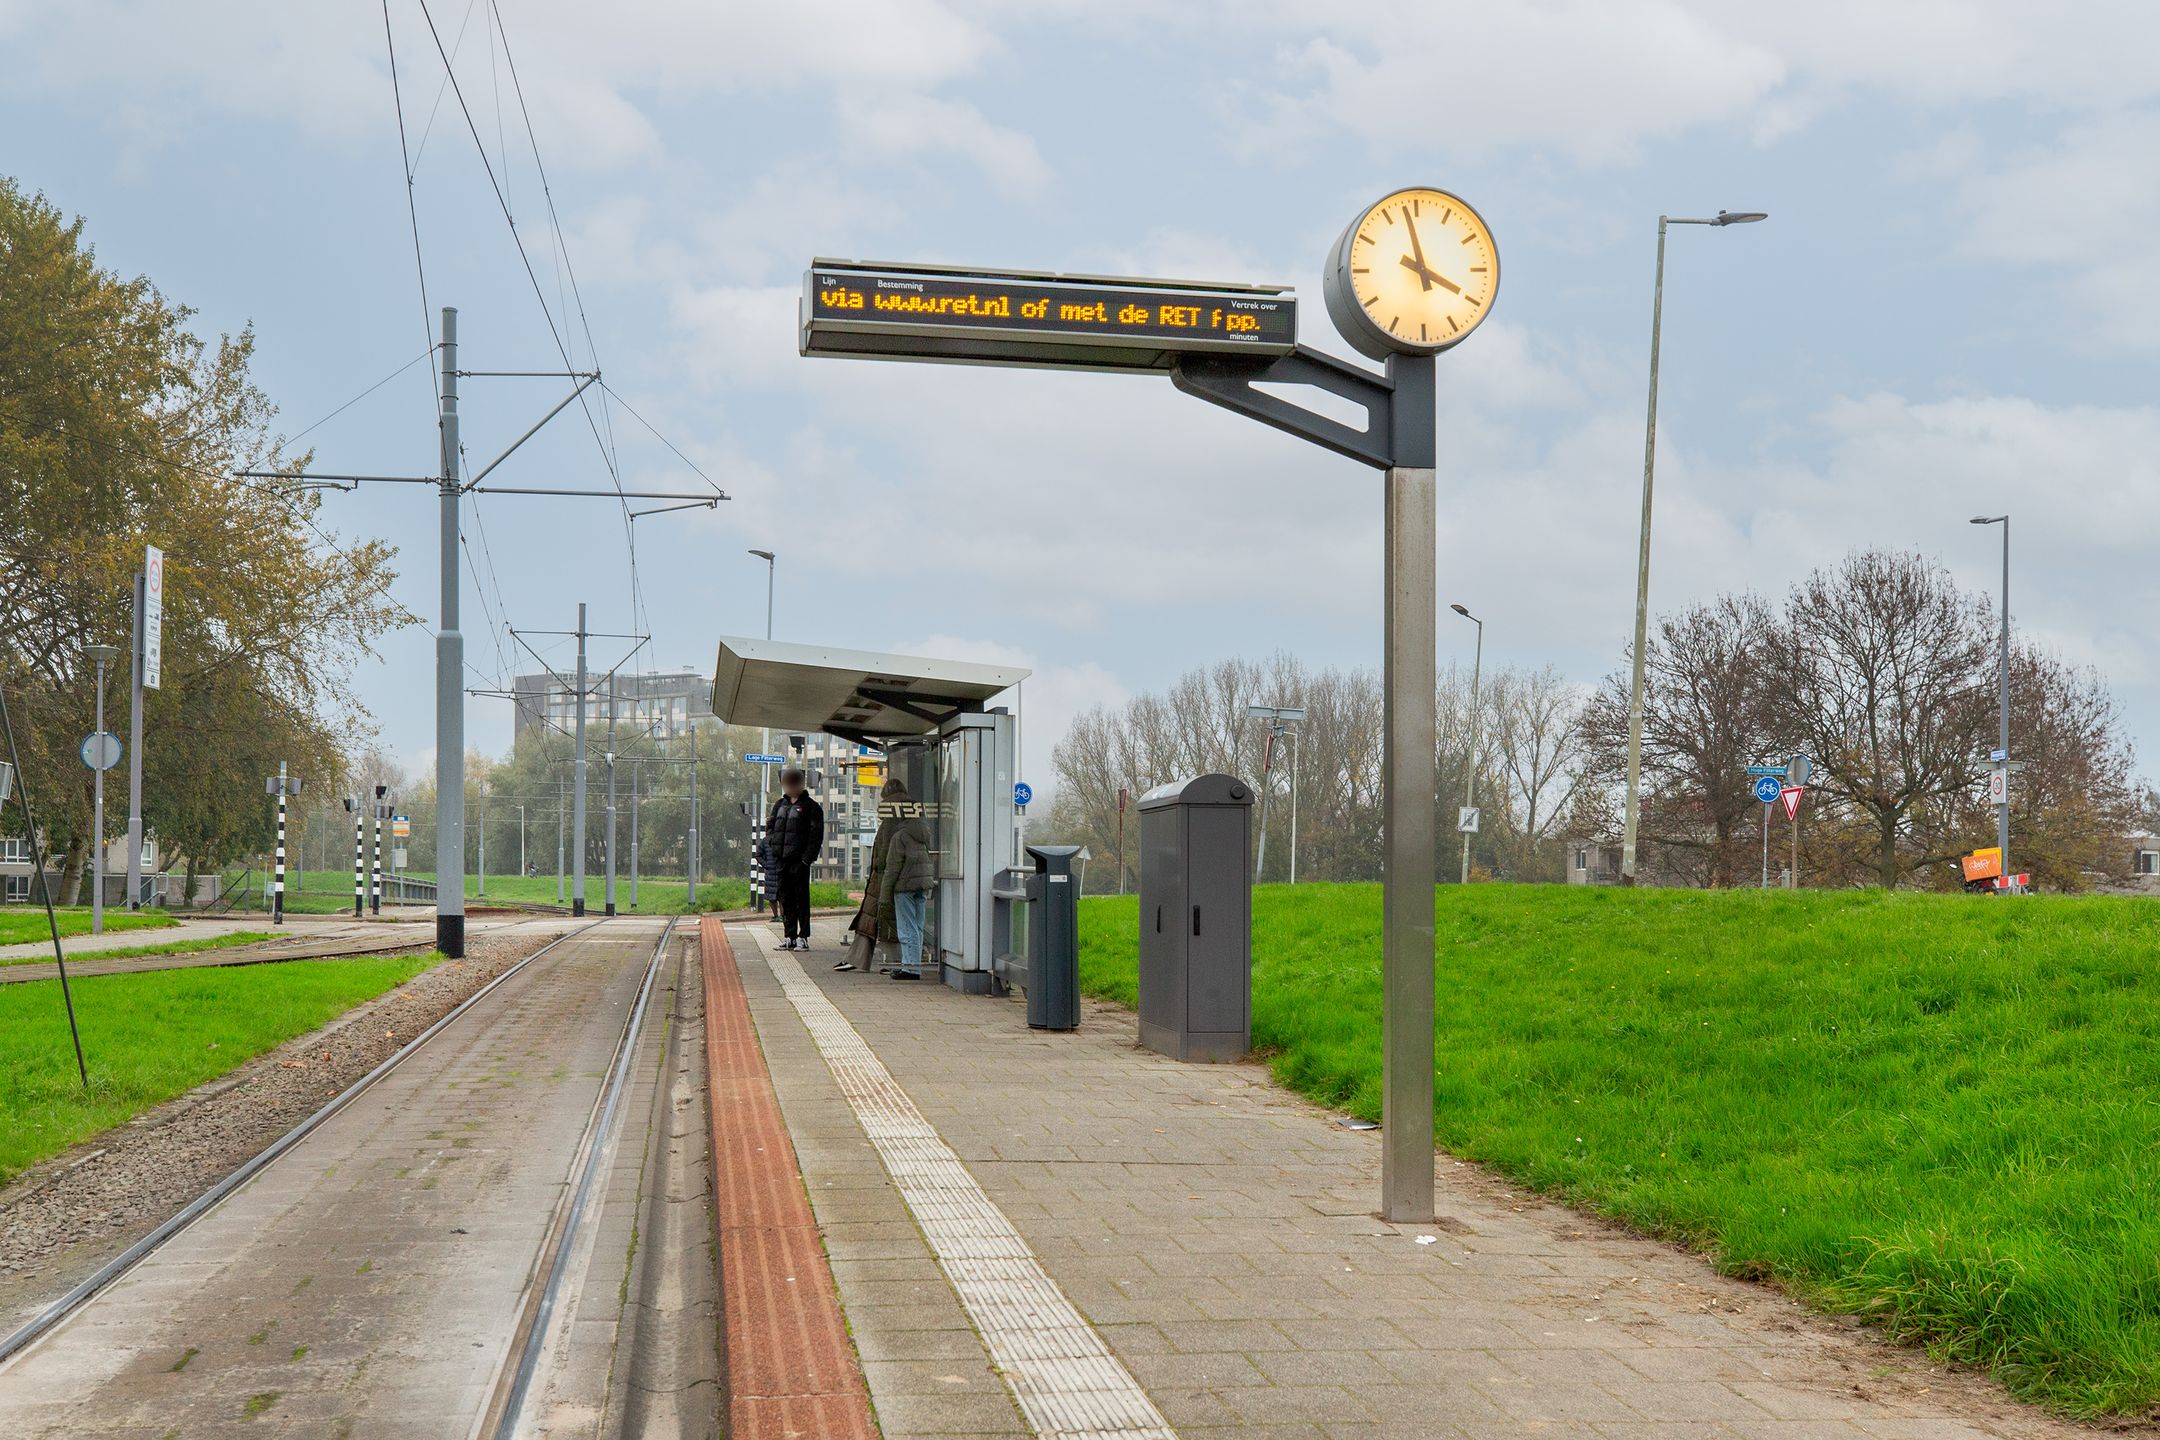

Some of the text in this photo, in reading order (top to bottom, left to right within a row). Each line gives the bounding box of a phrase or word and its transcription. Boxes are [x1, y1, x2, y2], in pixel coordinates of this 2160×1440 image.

[822, 276, 837, 287] Lijn
[877, 279, 924, 293] Bestemming
[821, 287, 864, 309] via
[1021, 298, 1050, 318] of
[1060, 302, 1108, 322] met
[1118, 303, 1149, 324] de
[1159, 305, 1201, 326] RET
[1230, 300, 1278, 311] Vertrek over
[1229, 332, 1259, 342] minuten
